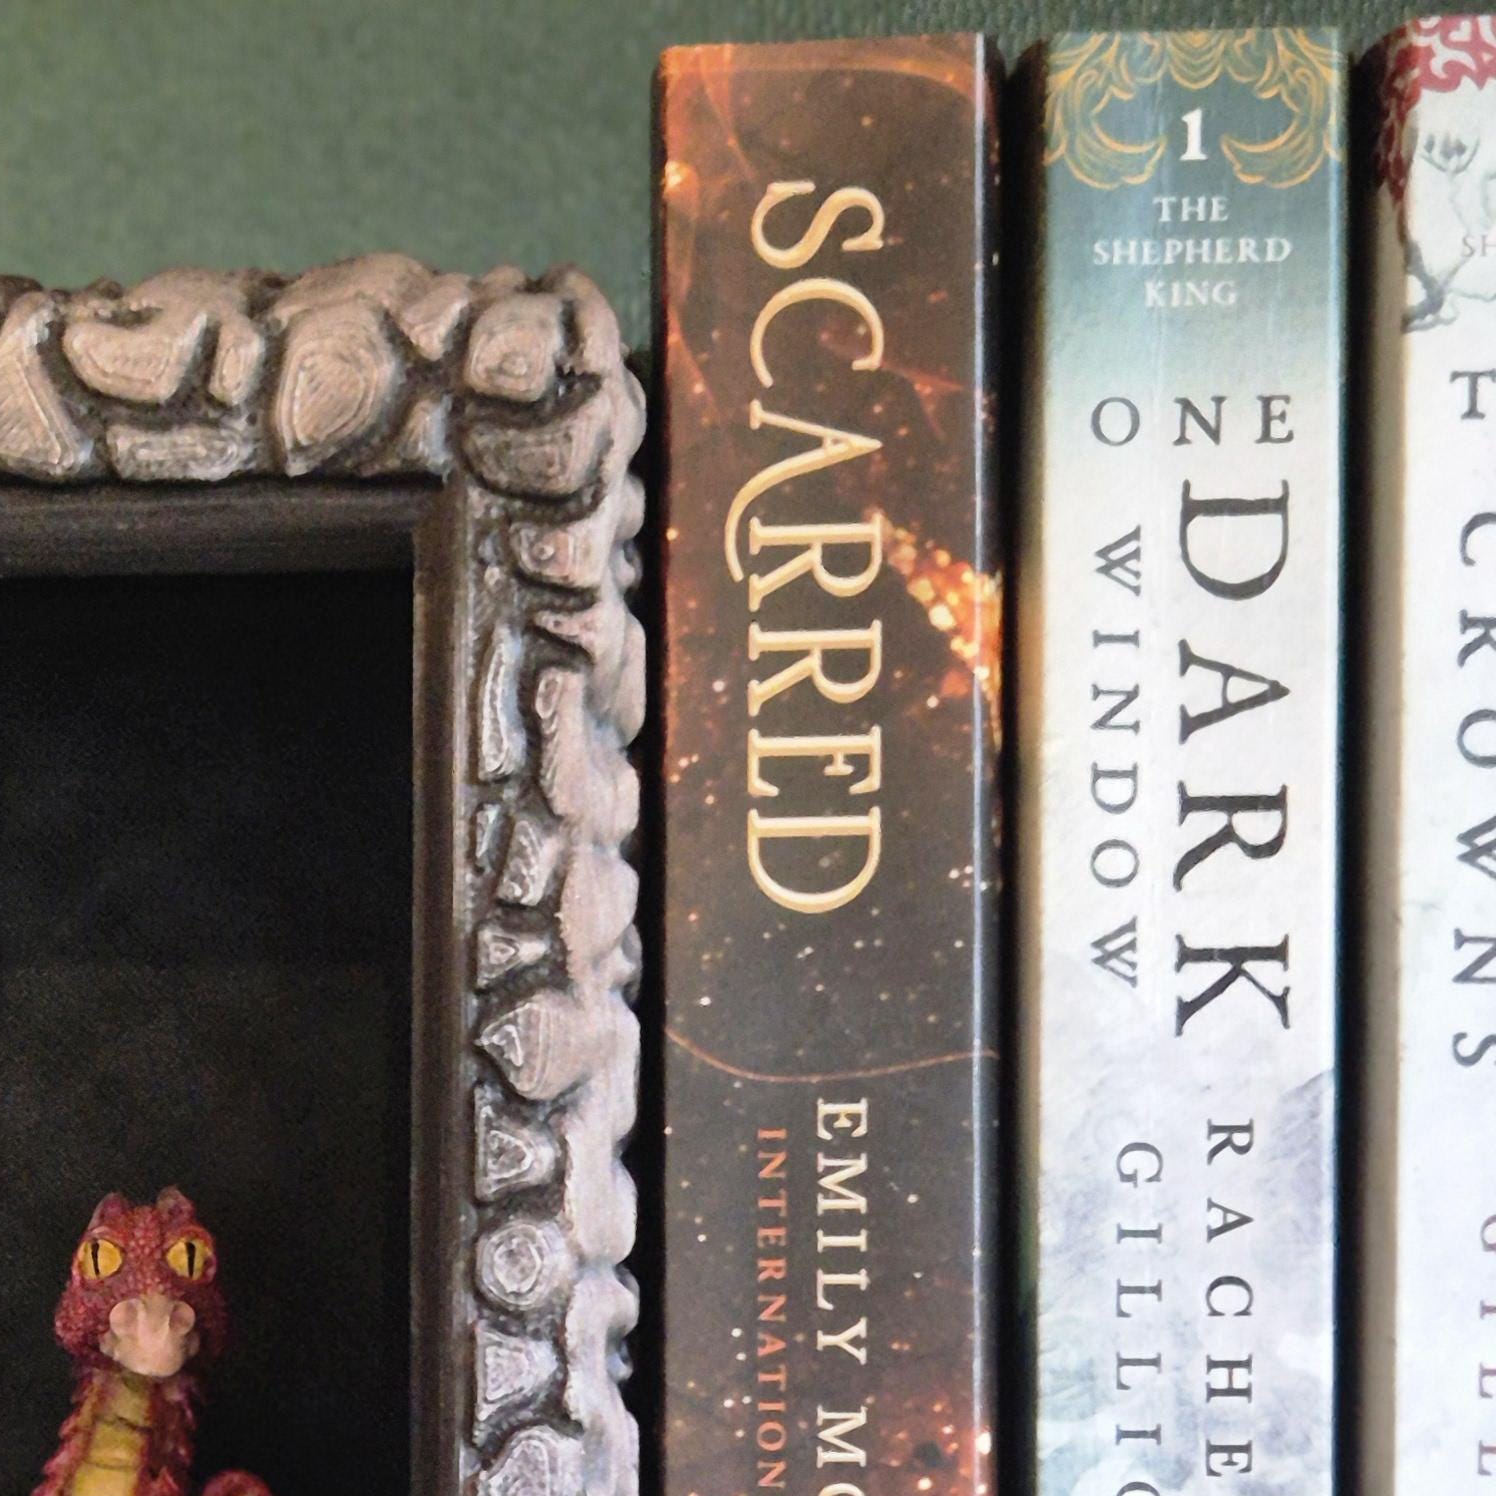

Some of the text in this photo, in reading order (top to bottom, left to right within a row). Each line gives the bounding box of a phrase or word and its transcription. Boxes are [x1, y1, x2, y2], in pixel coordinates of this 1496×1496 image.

[1179, 107, 1208, 161] 1
[1153, 195, 1229, 222] THE
[1092, 237, 1293, 265] SHEPHERD
[1144, 280, 1238, 307] KING
[1090, 394, 1295, 446] ONE
[725, 180, 884, 914] SCARRED
[1089, 525, 1142, 990] WINDOW
[1173, 480, 1292, 1040] DARK
[814, 1097, 868, 1366] EMILY
